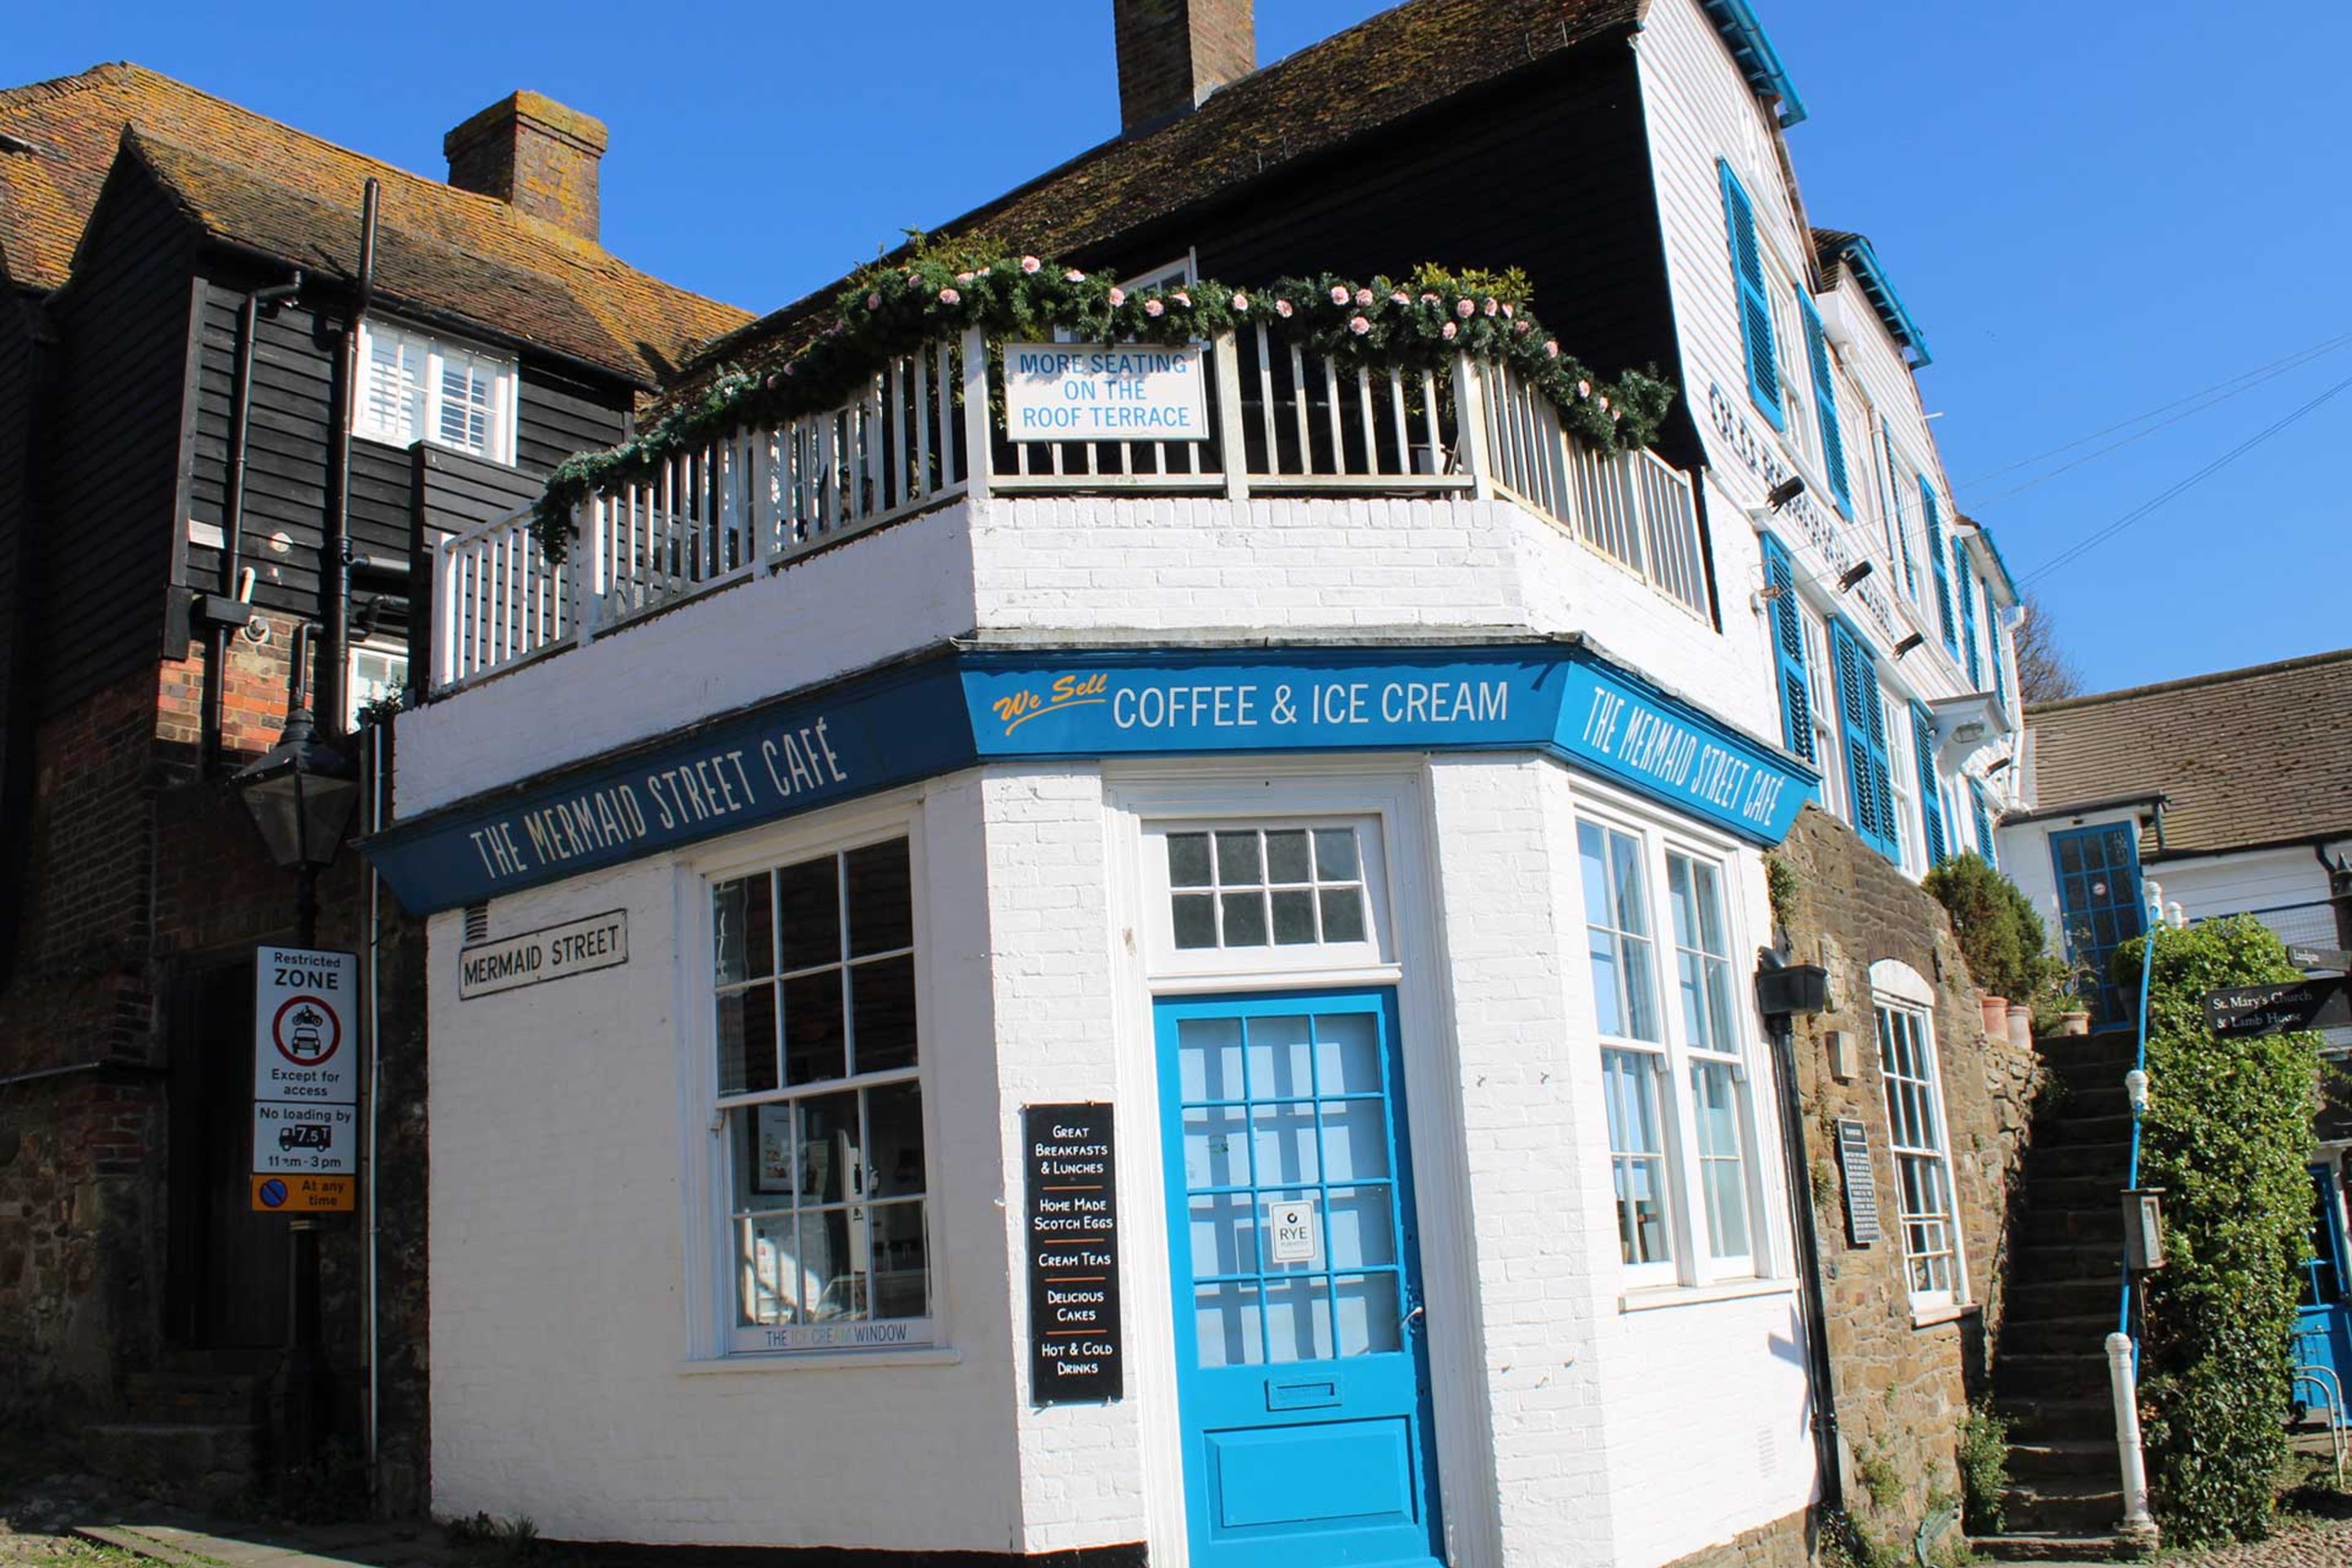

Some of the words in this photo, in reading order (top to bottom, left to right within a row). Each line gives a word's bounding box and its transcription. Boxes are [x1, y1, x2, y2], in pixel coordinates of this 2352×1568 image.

[1020, 354, 1084, 373] MORE
[1091, 354, 1187, 373] SEATING
[1065, 381, 1095, 400] ON
[1103, 381, 1147, 400] THE
[1022, 408, 1081, 427] ROOF
[1089, 408, 1191, 427] TERRACE
[993, 692, 1041, 722] We
[1051, 673, 1108, 699] Sell
[1112, 684, 1258, 729] COFFEE
[1271, 684, 1298, 725] &
[1312, 684, 1370, 724] ICE
[1381, 681, 1508, 723] CREAM
[1582, 685, 1625, 754] THE
[1618, 705, 1698, 786] MERMAID
[1690, 744, 1750, 811] STREET
[1743, 768, 1786, 826] CAFÉ
[470, 821, 528, 880] THE
[523, 783, 648, 865] MERMAID
[648, 750, 755, 831] STREET
[762, 716, 847, 796] CAFÉ
[274, 951, 341, 968] Restricted
[464, 946, 542, 987] MERMAID
[551, 924, 620, 964] STREET
[274, 969, 339, 990] ZONE
[2230, 995, 2268, 1009] Mary's
[2271, 989, 2313, 1003] Church
[2231, 1013, 2262, 1027] Lamb
[2265, 1012, 2301, 1024] House
[272, 1068, 317, 1082] Except
[322, 1070, 341, 1082] for
[283, 1085, 328, 1097] access
[260, 1107, 278, 1119] No
[283, 1108, 332, 1122] loading
[336, 1110, 351, 1123] by
[1040, 1162, 1050, 1175] &
[301, 1178, 316, 1192] At
[321, 1181, 345, 1193] any
[308, 1195, 338, 1206] time
[1279, 1226, 1308, 1241] RYE
[766, 1330, 787, 1347] THE
[854, 1323, 907, 1342] WINDOW
[1069, 1343, 1079, 1356] &
